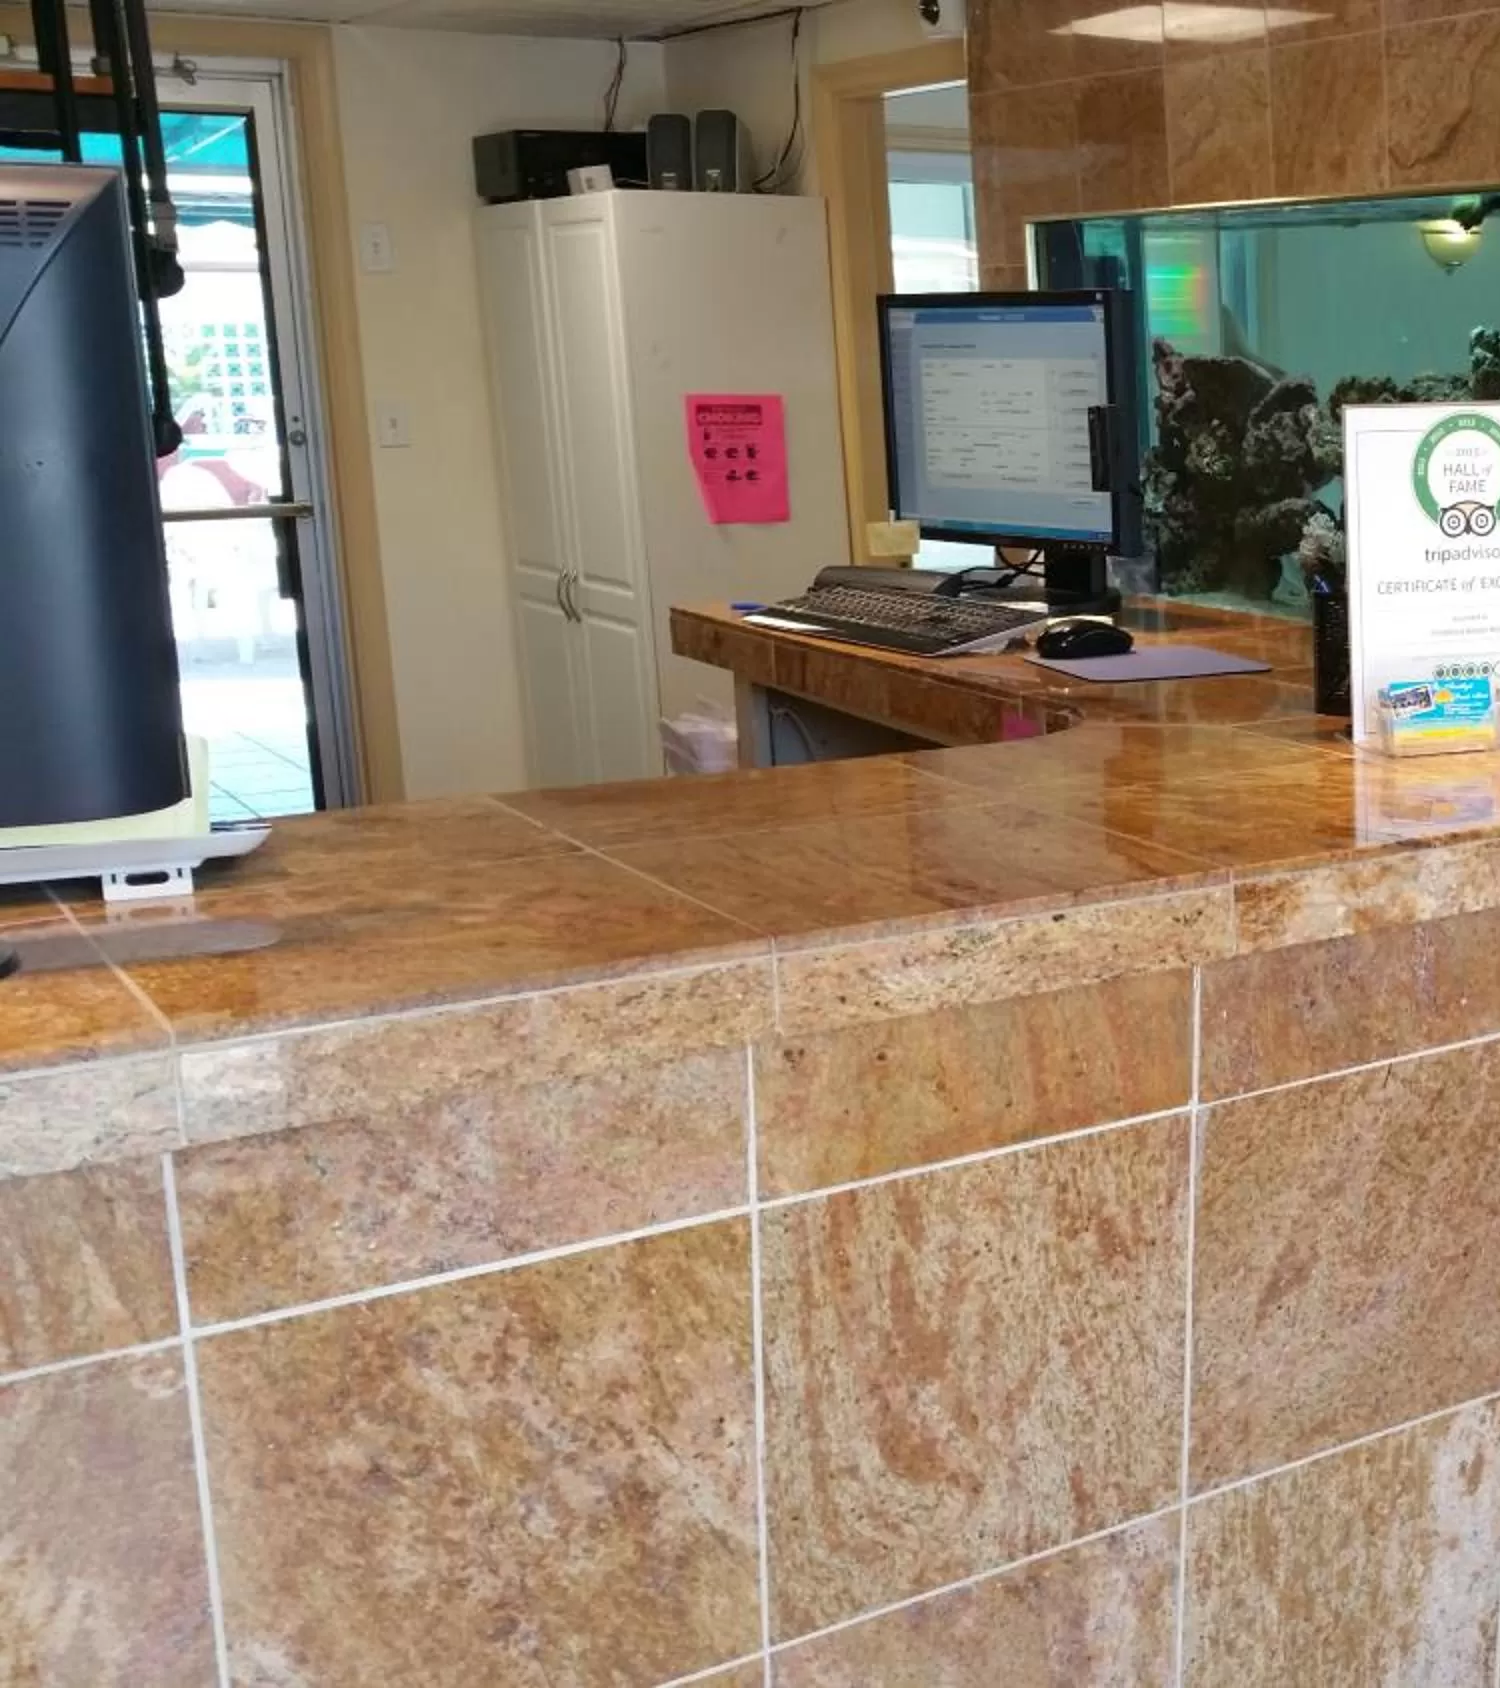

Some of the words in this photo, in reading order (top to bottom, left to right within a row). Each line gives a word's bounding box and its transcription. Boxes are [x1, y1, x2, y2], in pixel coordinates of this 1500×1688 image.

[1443, 463, 1480, 477] HALL
[1449, 479, 1487, 493] FAME
[1377, 579, 1457, 595] CERTIFICATE
[1461, 575, 1477, 593] of
